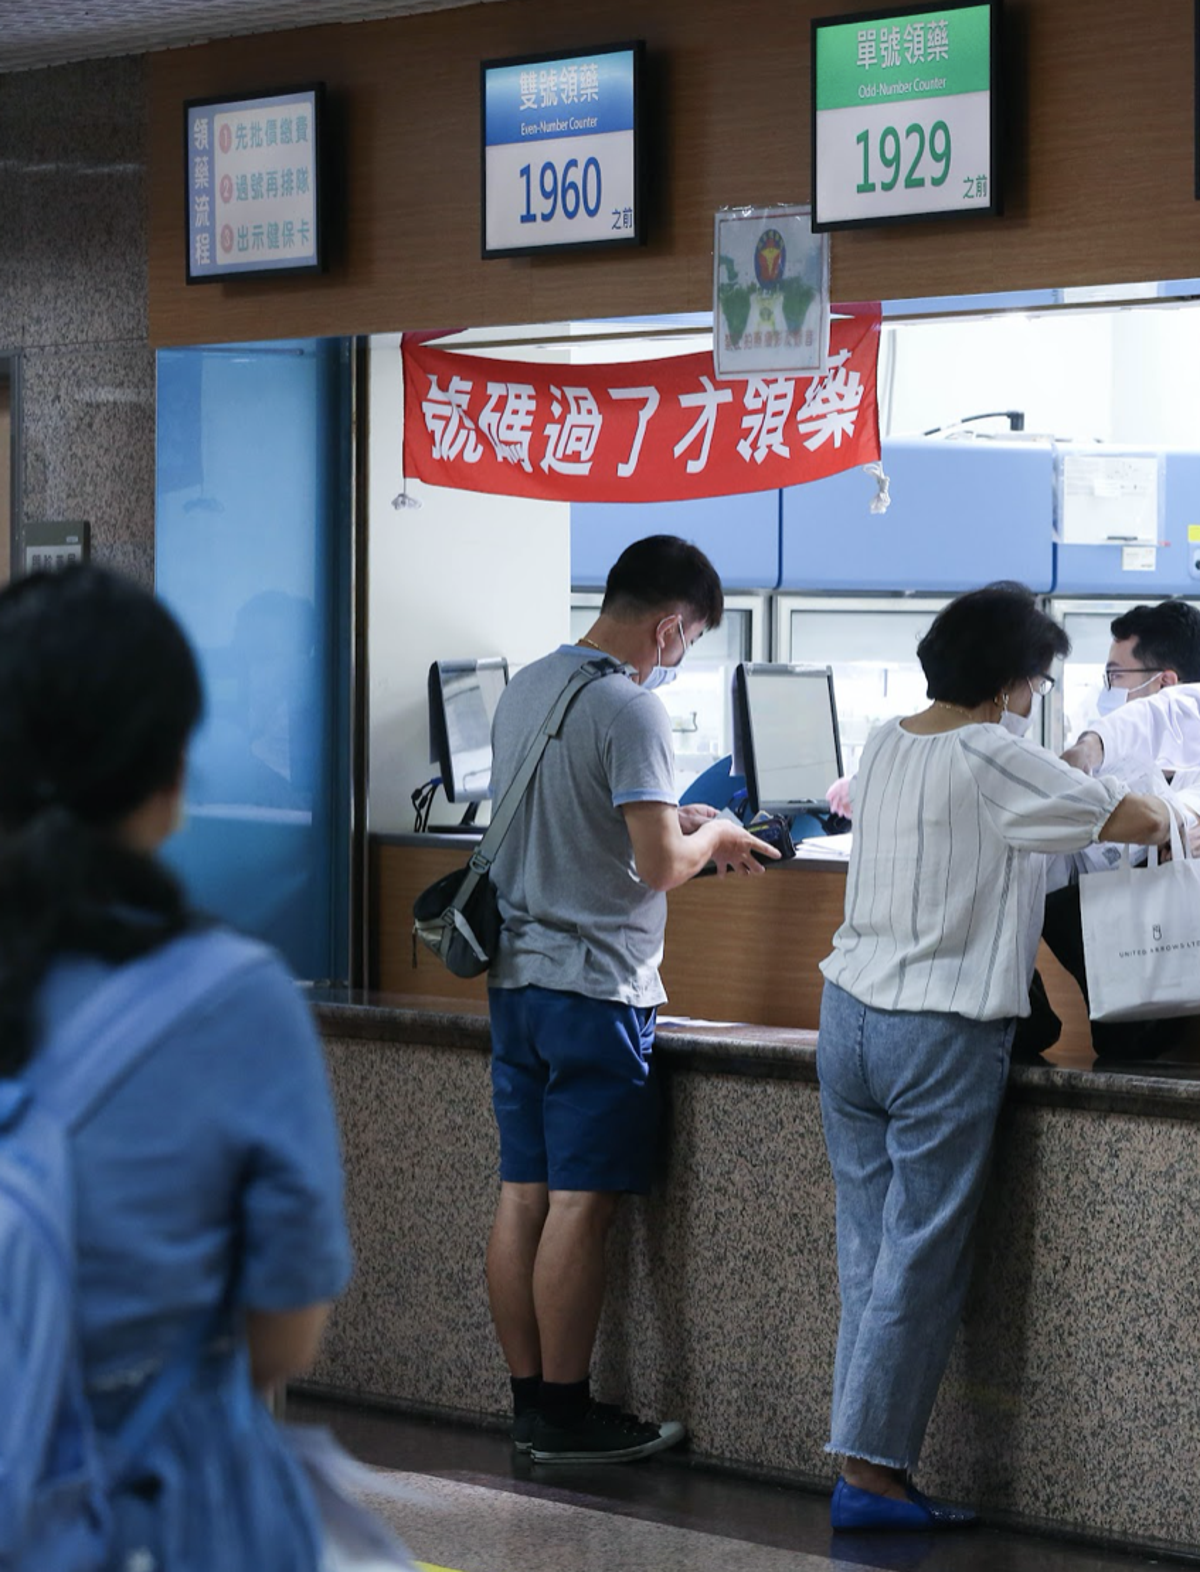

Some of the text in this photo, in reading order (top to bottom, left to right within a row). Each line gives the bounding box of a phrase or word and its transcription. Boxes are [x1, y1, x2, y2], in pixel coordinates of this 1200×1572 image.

[855, 20, 950, 70] 單號領藥
[518, 63, 600, 112] 雙號領藥
[857, 76, 948, 99] Odd-Number Counter
[235, 115, 308, 151] 先批價繳費
[520, 116, 599, 137] Even-Number Counter
[855, 120, 953, 195] 1929
[193, 118, 211, 266] 領藥流程
[235, 167, 309, 202] 過號再排隊
[518, 156, 603, 223] 1960
[962, 173, 988, 200] 之前
[236, 219, 309, 252] 出示健保卡
[611, 206, 633, 231] 之前
[420, 348, 865, 477] 號碼過了才領藥
[1118, 948, 1147, 959] UNITED
